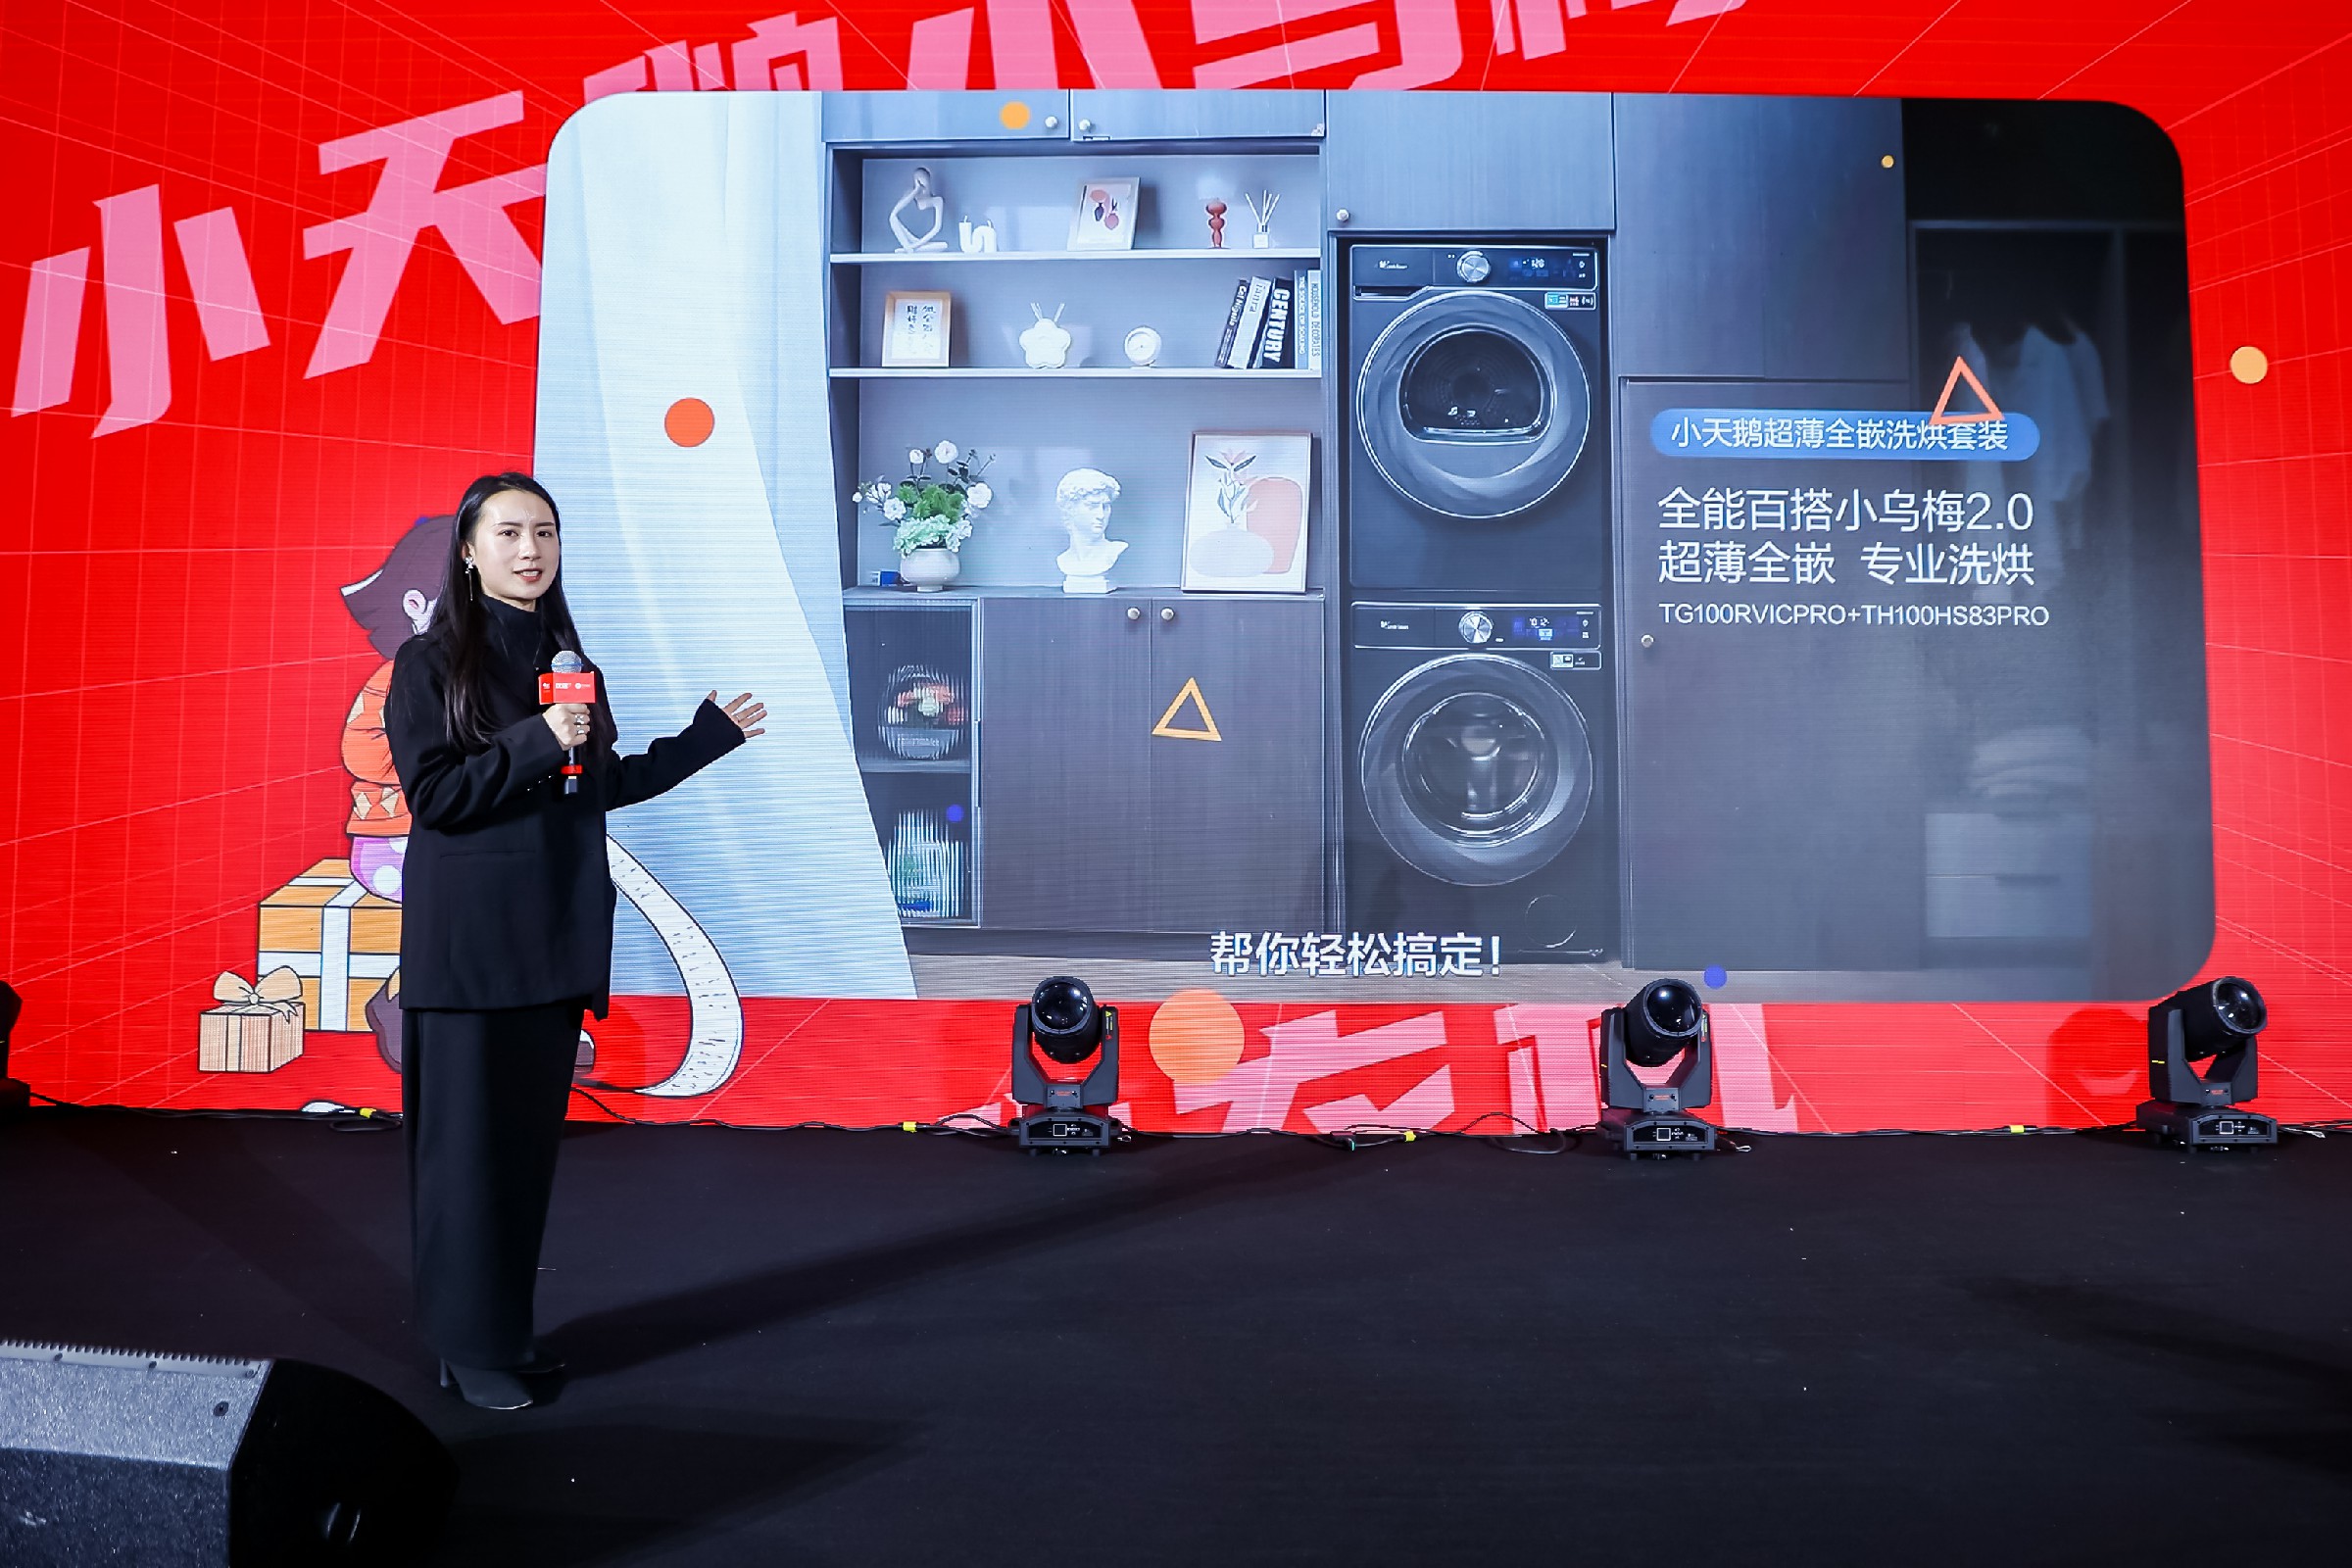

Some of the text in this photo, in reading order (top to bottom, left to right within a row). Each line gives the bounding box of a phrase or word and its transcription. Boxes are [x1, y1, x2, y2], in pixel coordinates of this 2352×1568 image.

[1263, 288, 1291, 363] CENTURY
[1671, 416, 2009, 451] 小天鹅超薄全嵌洗烘套装
[1657, 486, 2034, 532] 全能百搭小乌梅2.0
[1658, 540, 2035, 586] 超薄全嵌 专业洗烘
[1658, 603, 2049, 626] TG100RVICPRO+TH100HS83PRO
[1209, 930, 1500, 977] 帮你轻松搞定！
